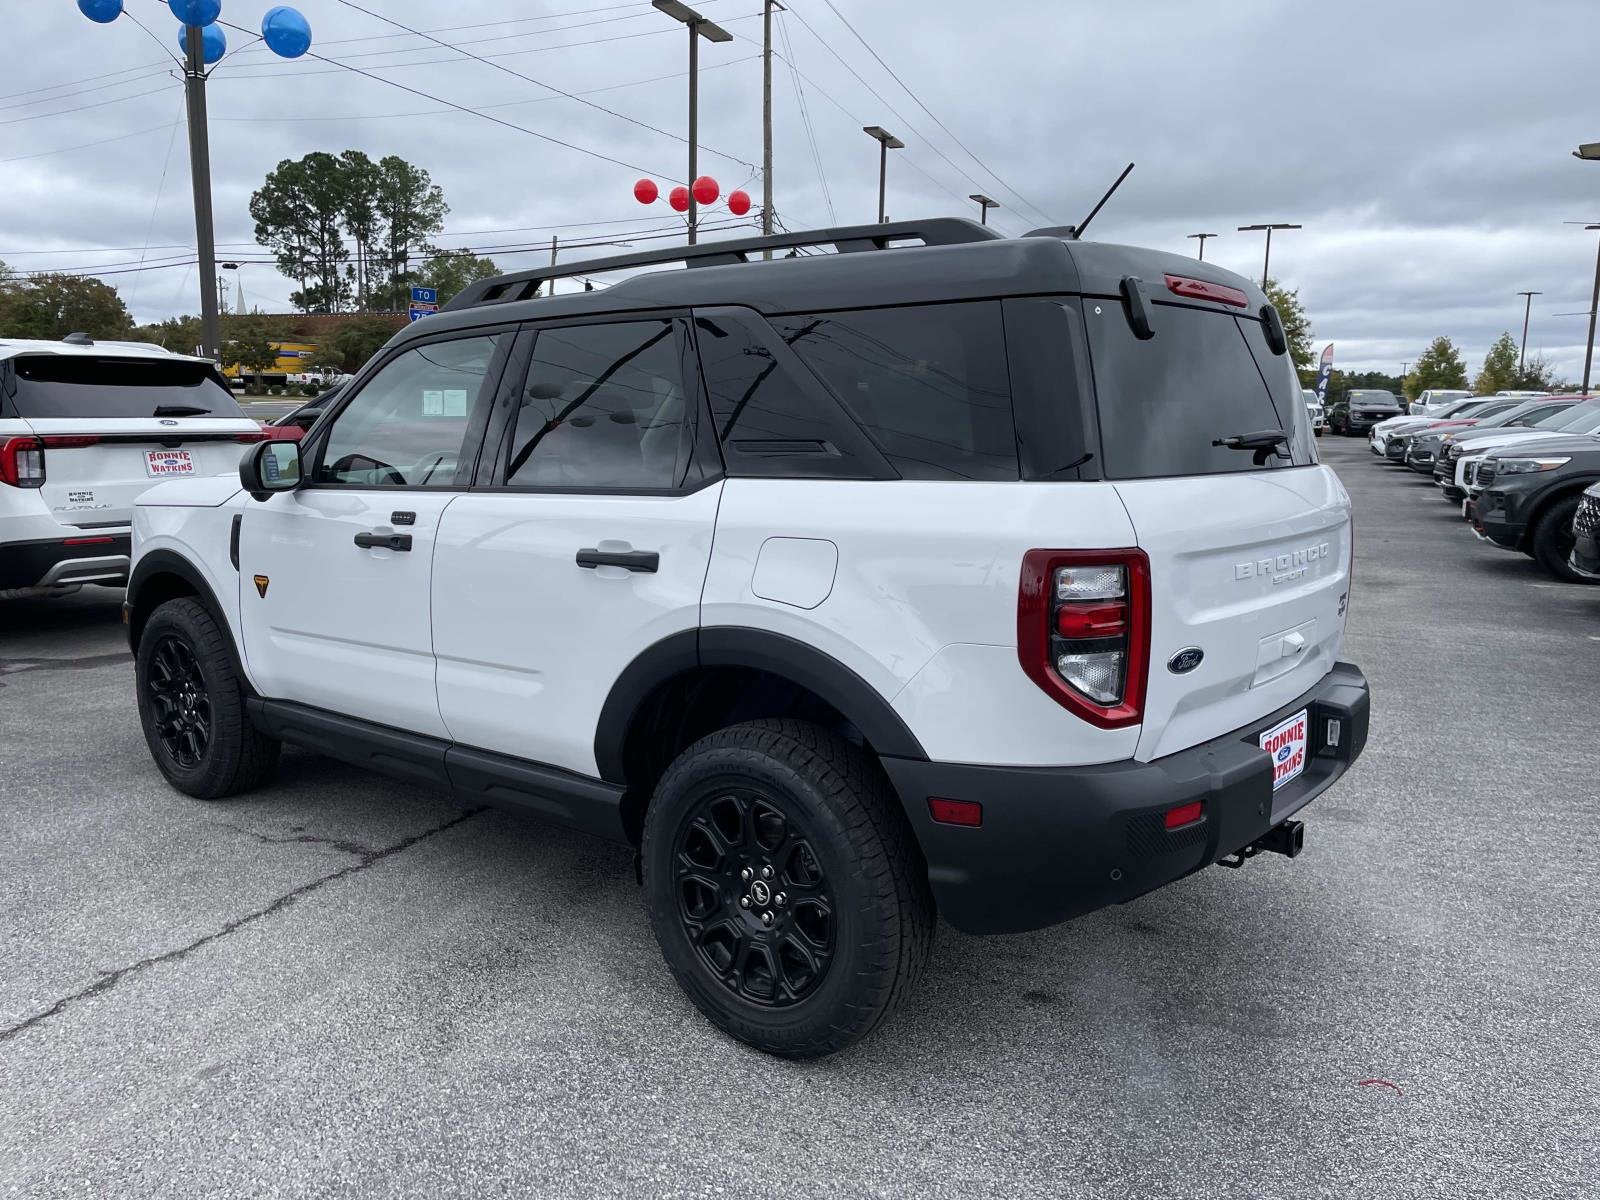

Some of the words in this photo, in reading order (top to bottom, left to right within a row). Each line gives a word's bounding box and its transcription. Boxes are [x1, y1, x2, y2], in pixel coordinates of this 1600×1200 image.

[417, 290, 430, 300] TO
[149, 452, 190, 462] RONNIE
[151, 462, 193, 473] WATKINS
[1234, 542, 1329, 581] BRONCO
[1272, 566, 1309, 585] SPORT
[1264, 720, 1304, 754] RONNIE
